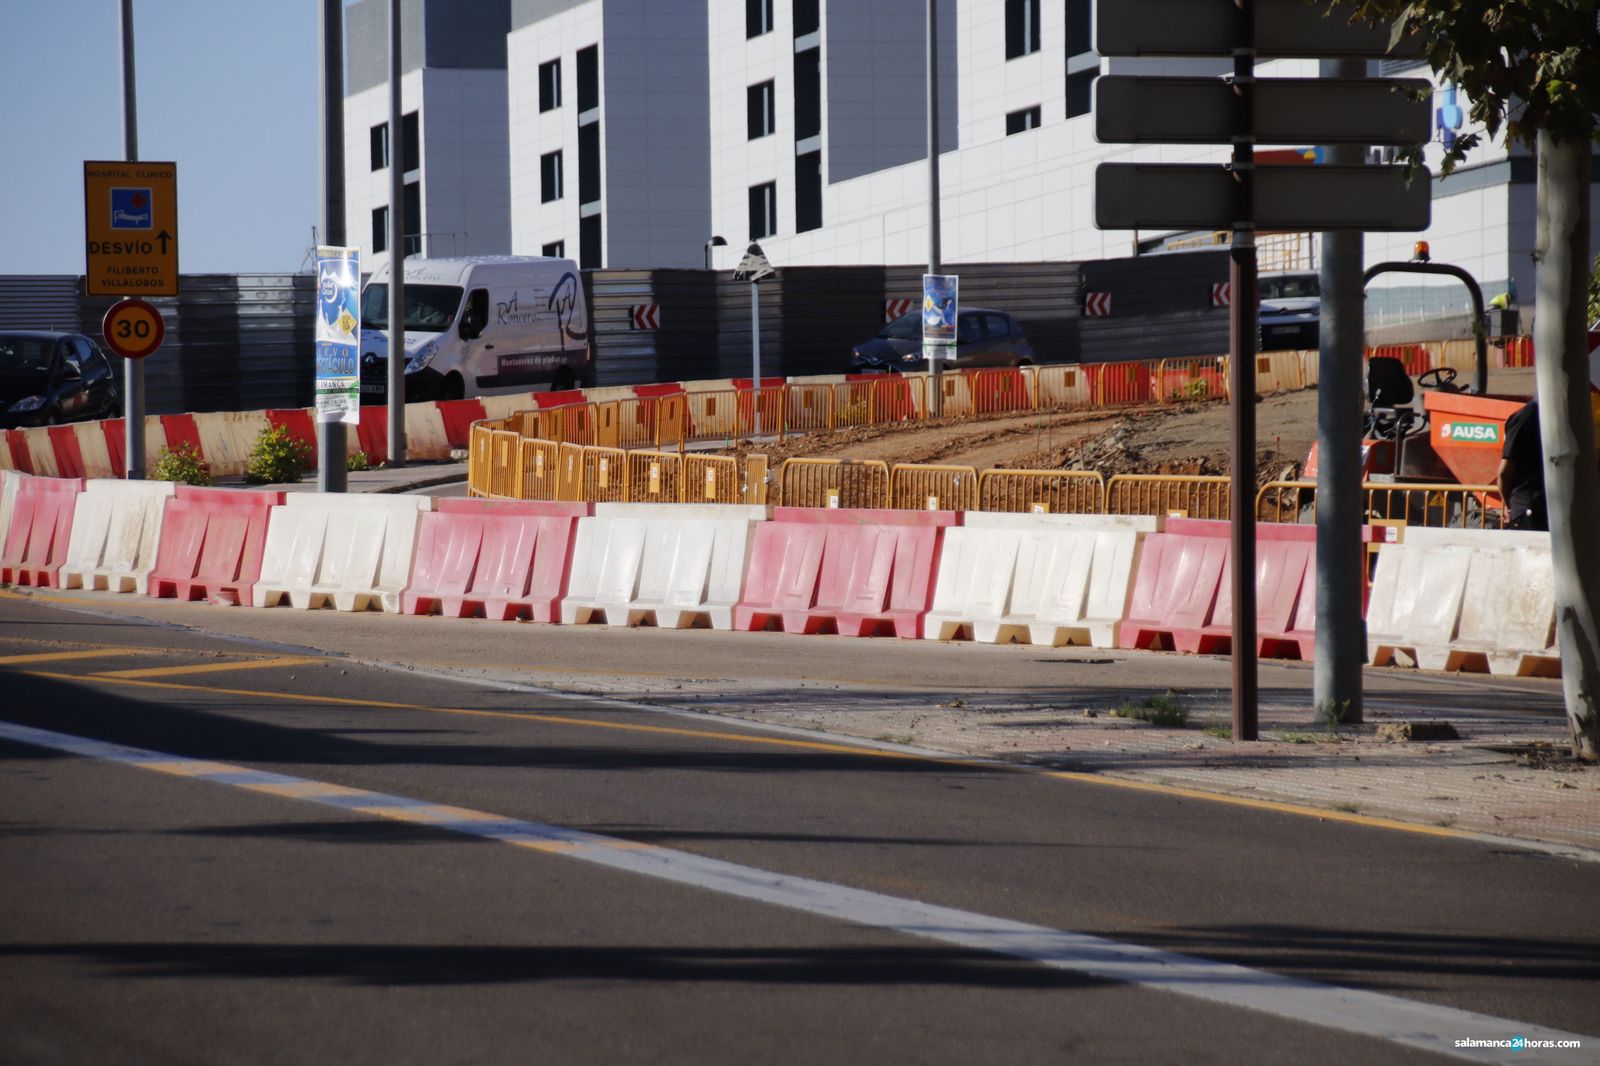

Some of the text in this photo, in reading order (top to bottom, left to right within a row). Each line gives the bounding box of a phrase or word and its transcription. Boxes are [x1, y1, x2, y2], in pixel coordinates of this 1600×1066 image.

[88, 170, 130, 178] HOSPITAL
[89, 239, 153, 255] DESVÍO
[106, 266, 159, 274] FILIBERTO
[101, 279, 165, 287] VILLALOBOS
[117, 319, 150, 339] 30
[1452, 425, 1496, 439] AUSA
